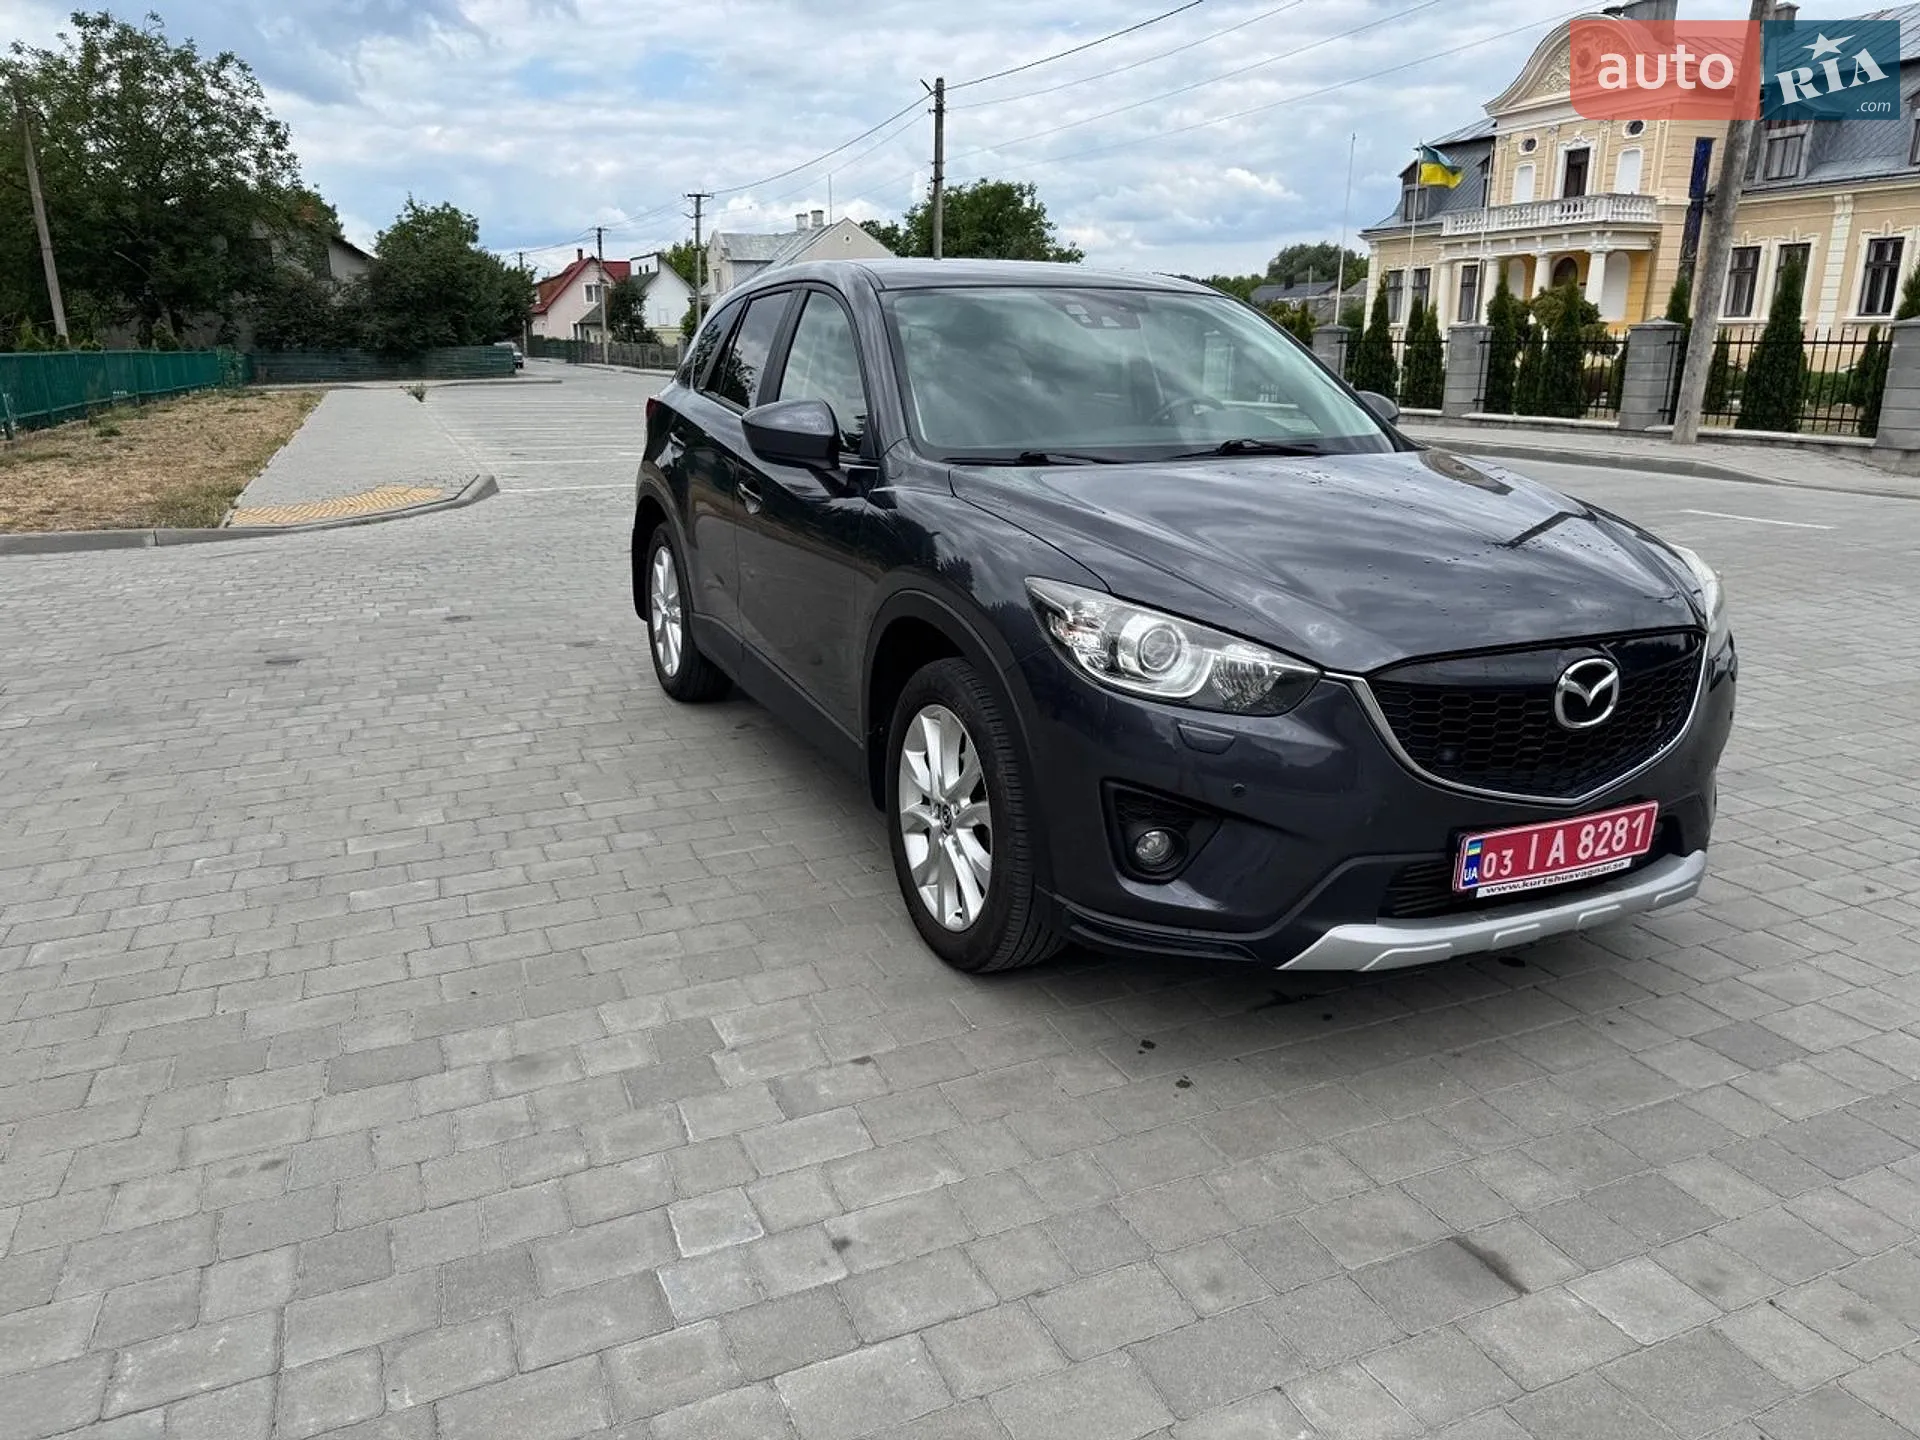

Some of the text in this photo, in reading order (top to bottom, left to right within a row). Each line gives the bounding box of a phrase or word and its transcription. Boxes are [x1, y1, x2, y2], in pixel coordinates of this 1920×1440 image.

[1482, 812, 1647, 879] 03 IA 8281
[1463, 867, 1479, 881] UA
